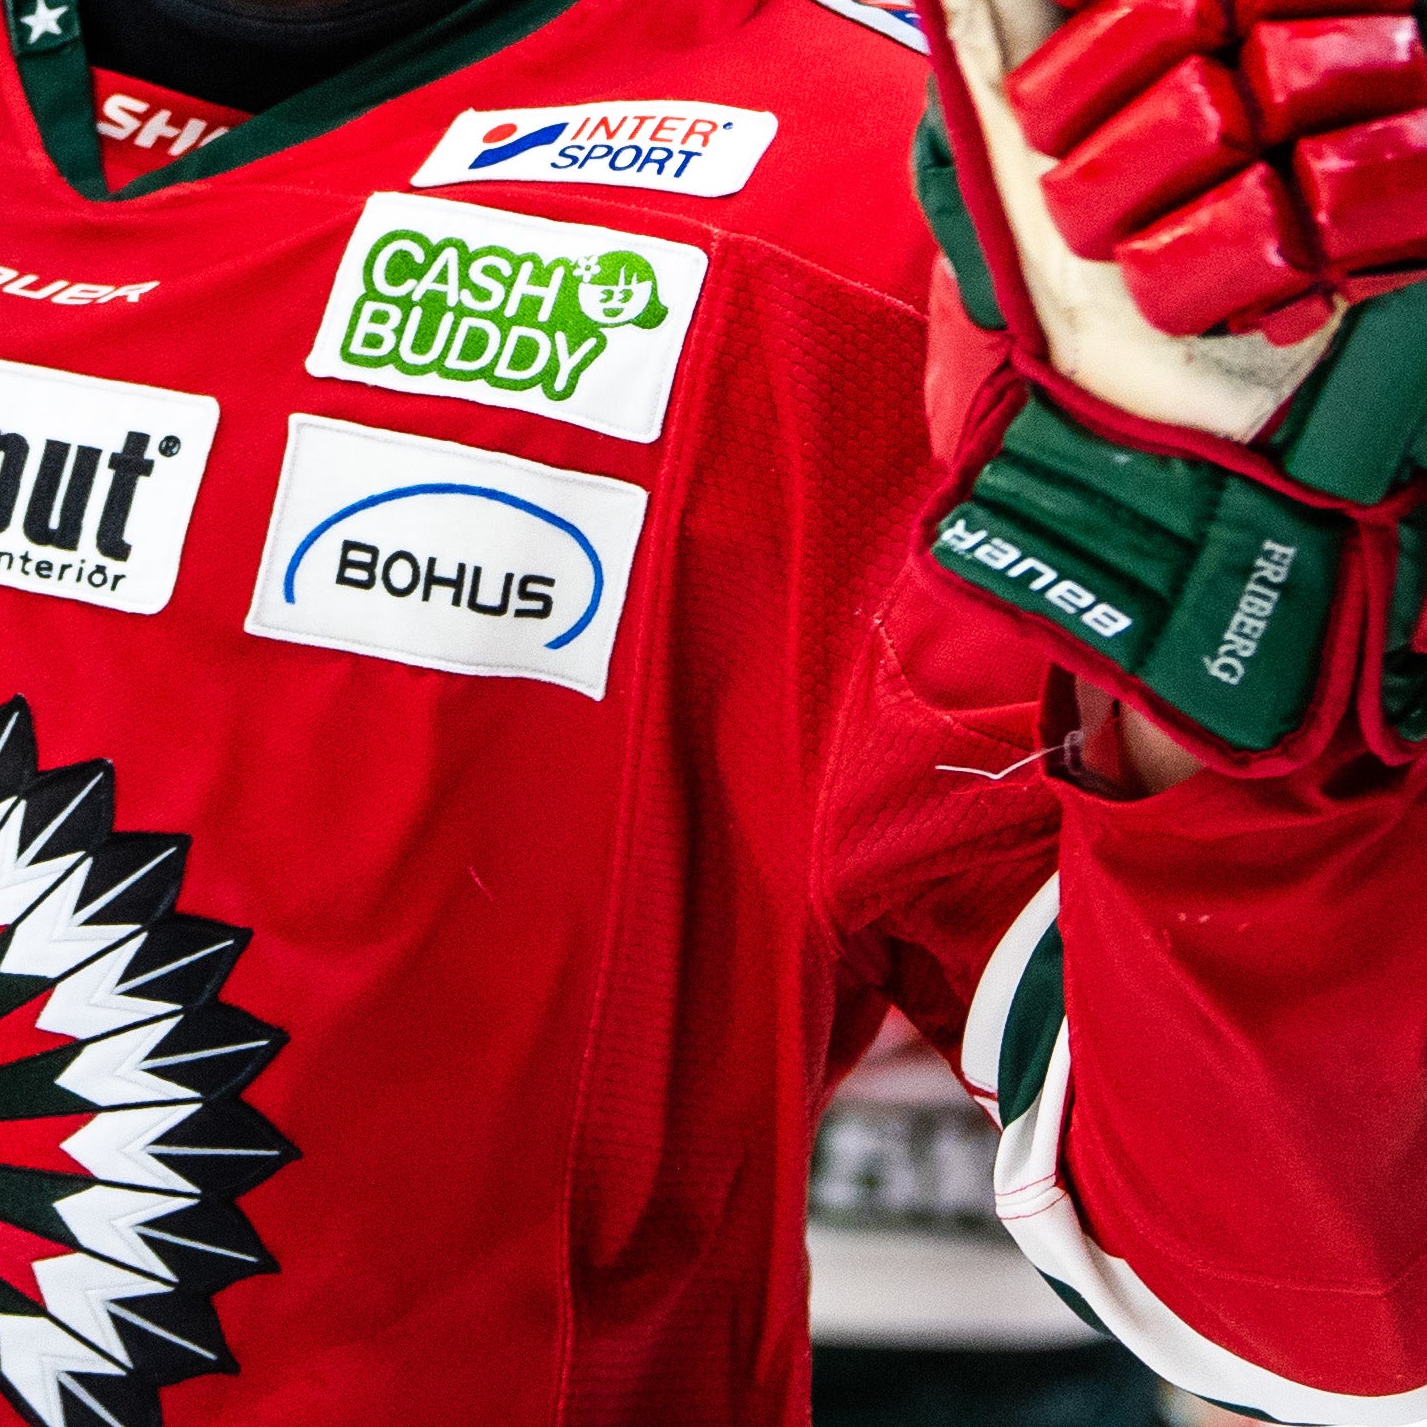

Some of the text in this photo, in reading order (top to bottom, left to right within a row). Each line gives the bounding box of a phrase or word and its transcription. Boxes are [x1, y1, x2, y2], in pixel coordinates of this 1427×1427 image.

[96, 92, 232, 157] SH
[548, 142, 704, 181] SPORT
[569, 113, 719, 150] INTER
[368, 235, 570, 328] CASH
[344, 299, 600, 396] BUDDY
[334, 538, 557, 621] BOHUS
